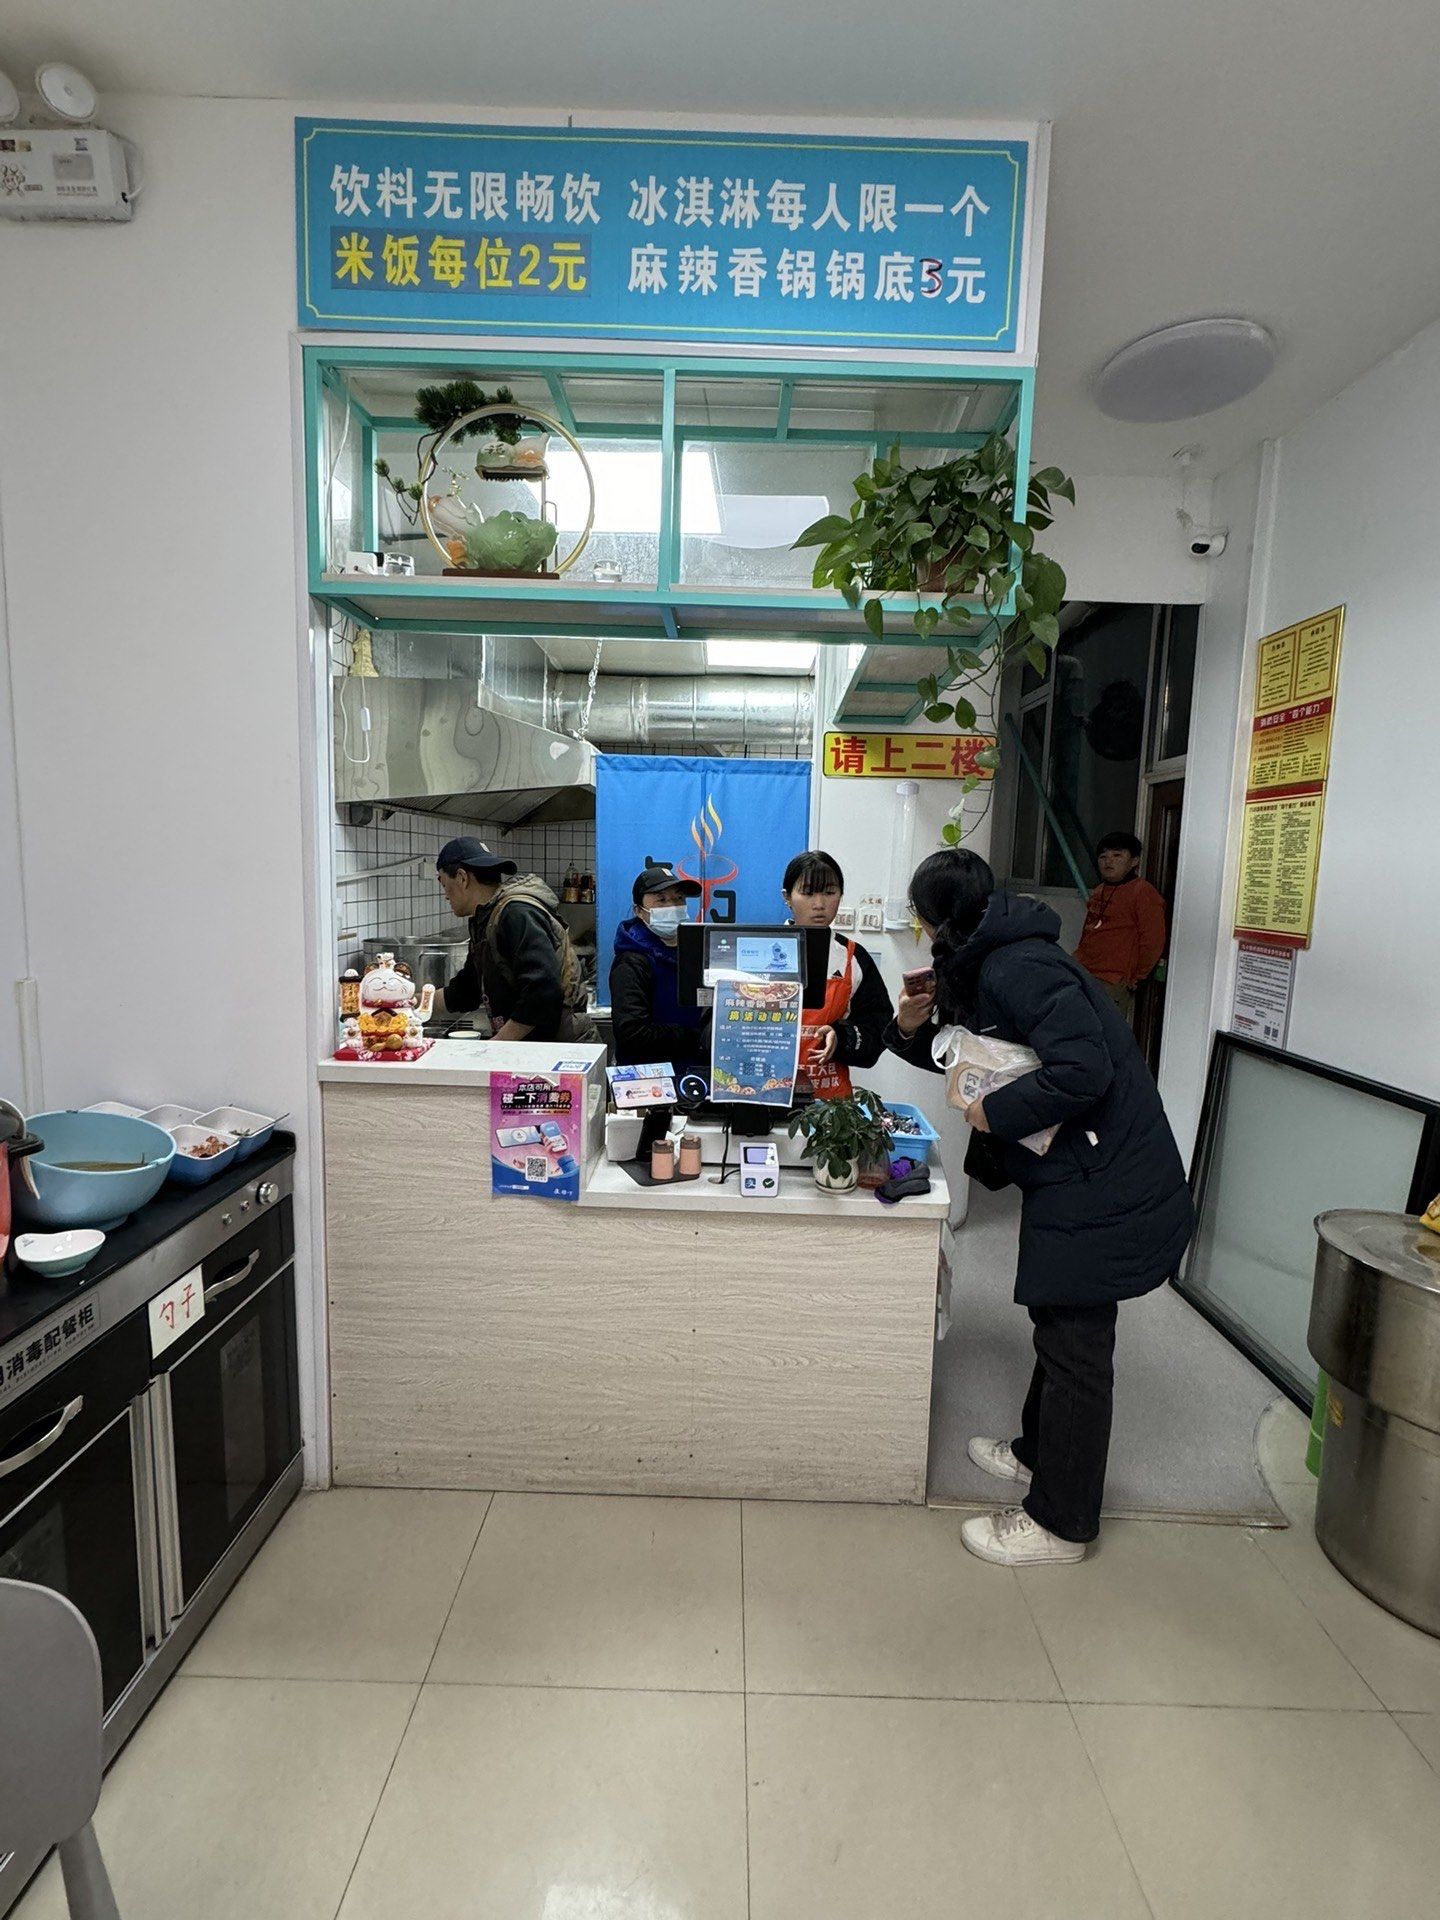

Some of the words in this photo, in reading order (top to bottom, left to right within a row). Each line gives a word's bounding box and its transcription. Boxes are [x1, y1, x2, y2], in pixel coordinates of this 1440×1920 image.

[330, 164, 601, 226] 饮料无限畅饮
[627, 176, 990, 237] 冰淇淋每人限一个
[335, 232, 587, 292] 米饭每位2元
[830, 736, 986, 776] 请上二楼
